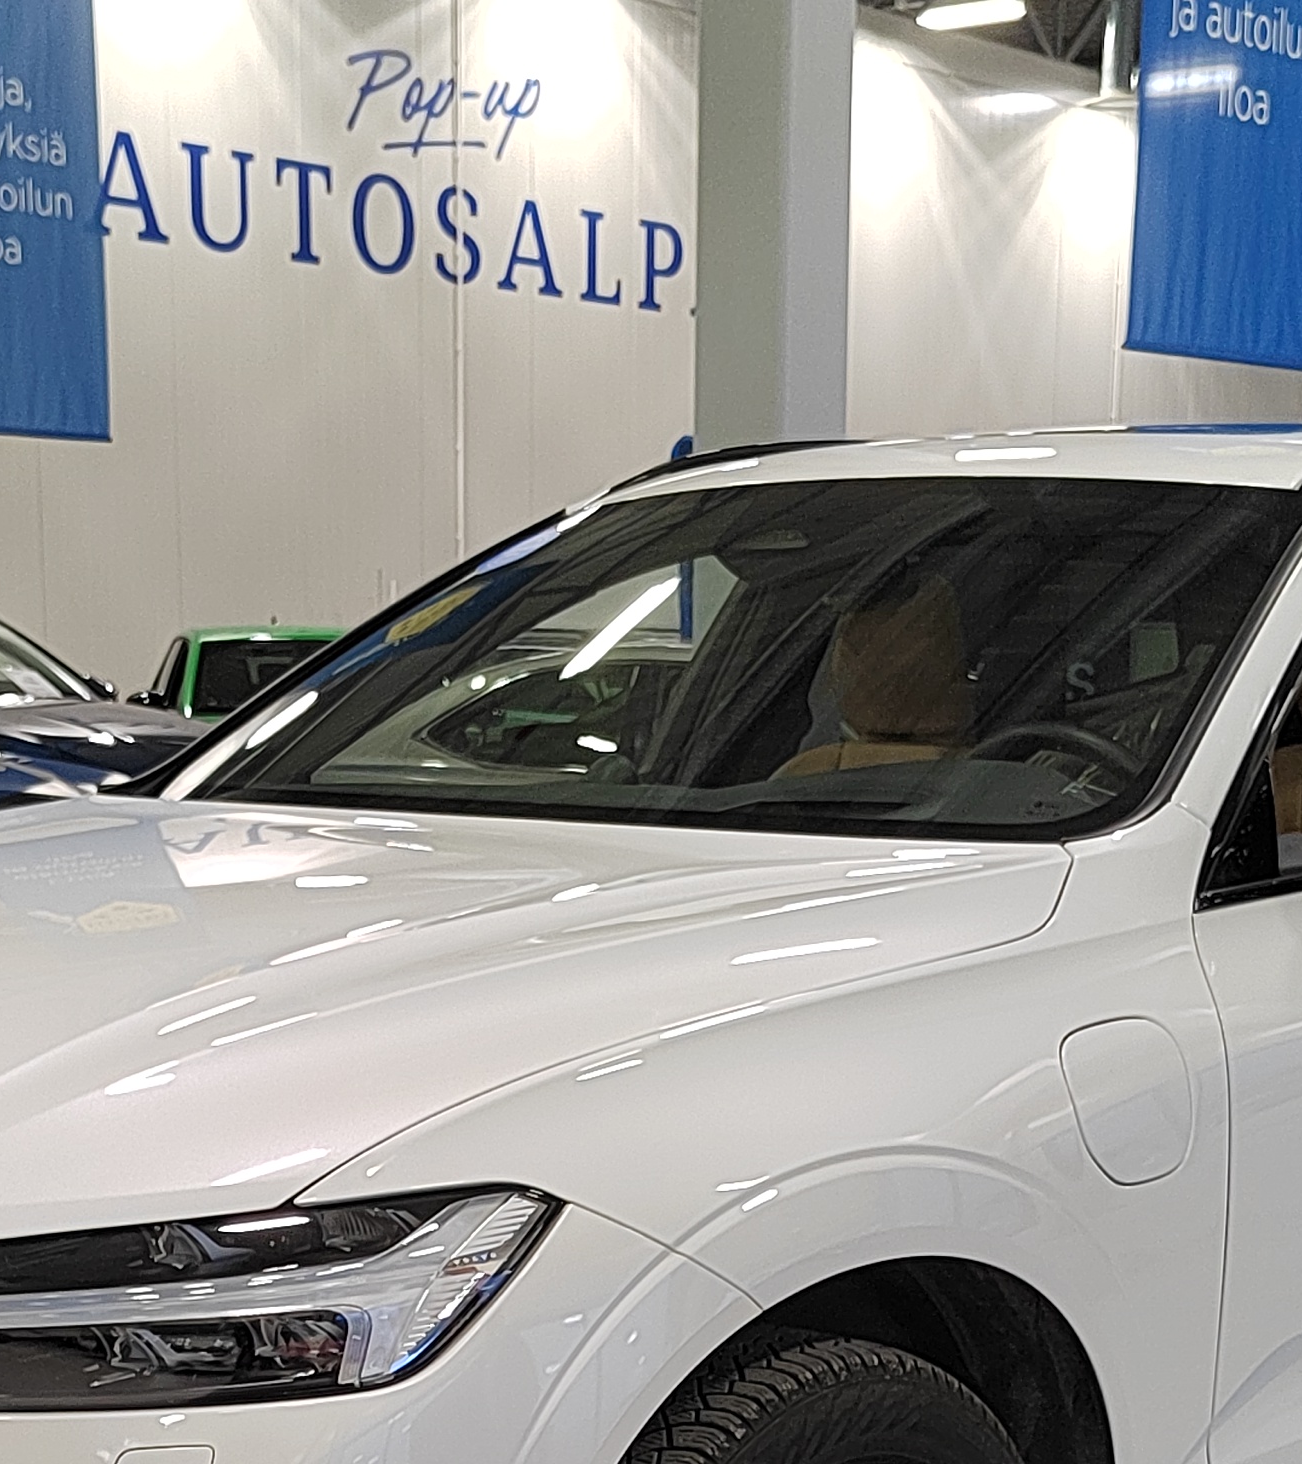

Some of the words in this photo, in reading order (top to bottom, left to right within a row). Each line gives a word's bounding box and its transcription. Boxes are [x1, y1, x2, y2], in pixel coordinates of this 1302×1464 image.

[1169, 0, 1198, 39] ja
[347, 48, 541, 161] Pop-up
[99, 130, 696, 316] AUTOSALP
